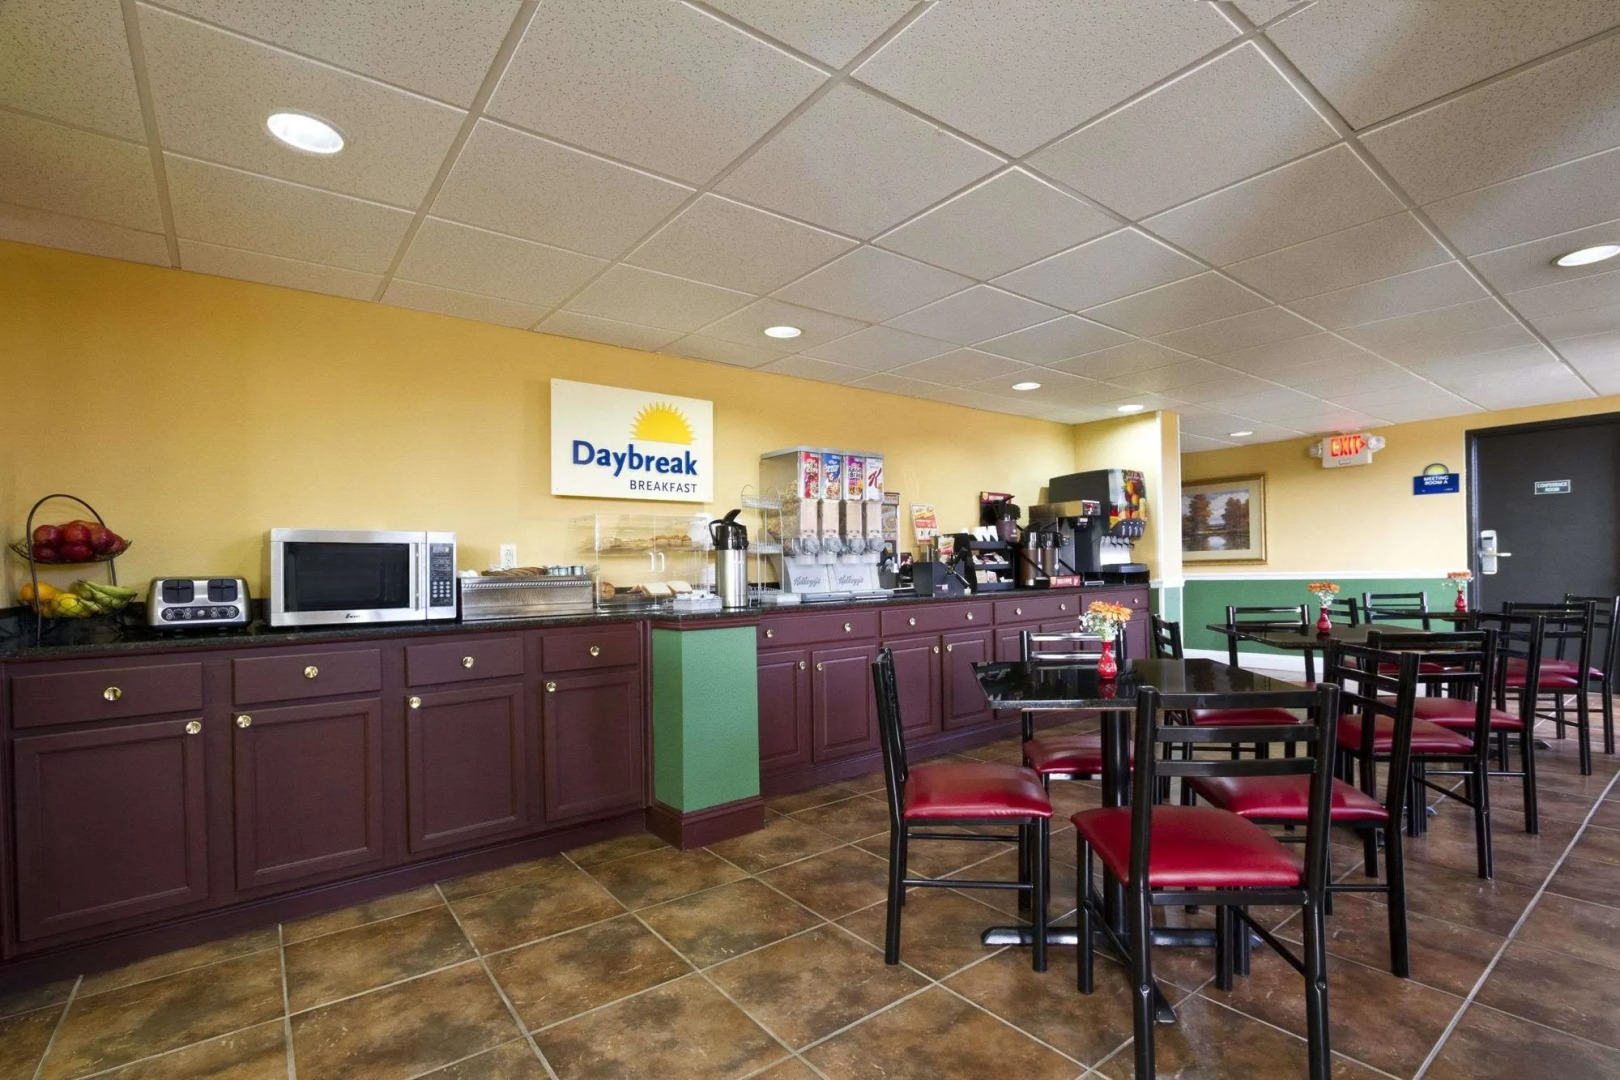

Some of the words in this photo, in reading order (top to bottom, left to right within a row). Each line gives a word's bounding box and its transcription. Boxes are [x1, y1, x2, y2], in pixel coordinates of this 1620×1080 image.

[1331, 435, 1361, 457] EXIT
[573, 440, 698, 477] Daybreak
[630, 480, 698, 493] BREAKFAST
[793, 575, 821, 587] Kellogg's
[838, 575, 864, 587] Kellogg's
